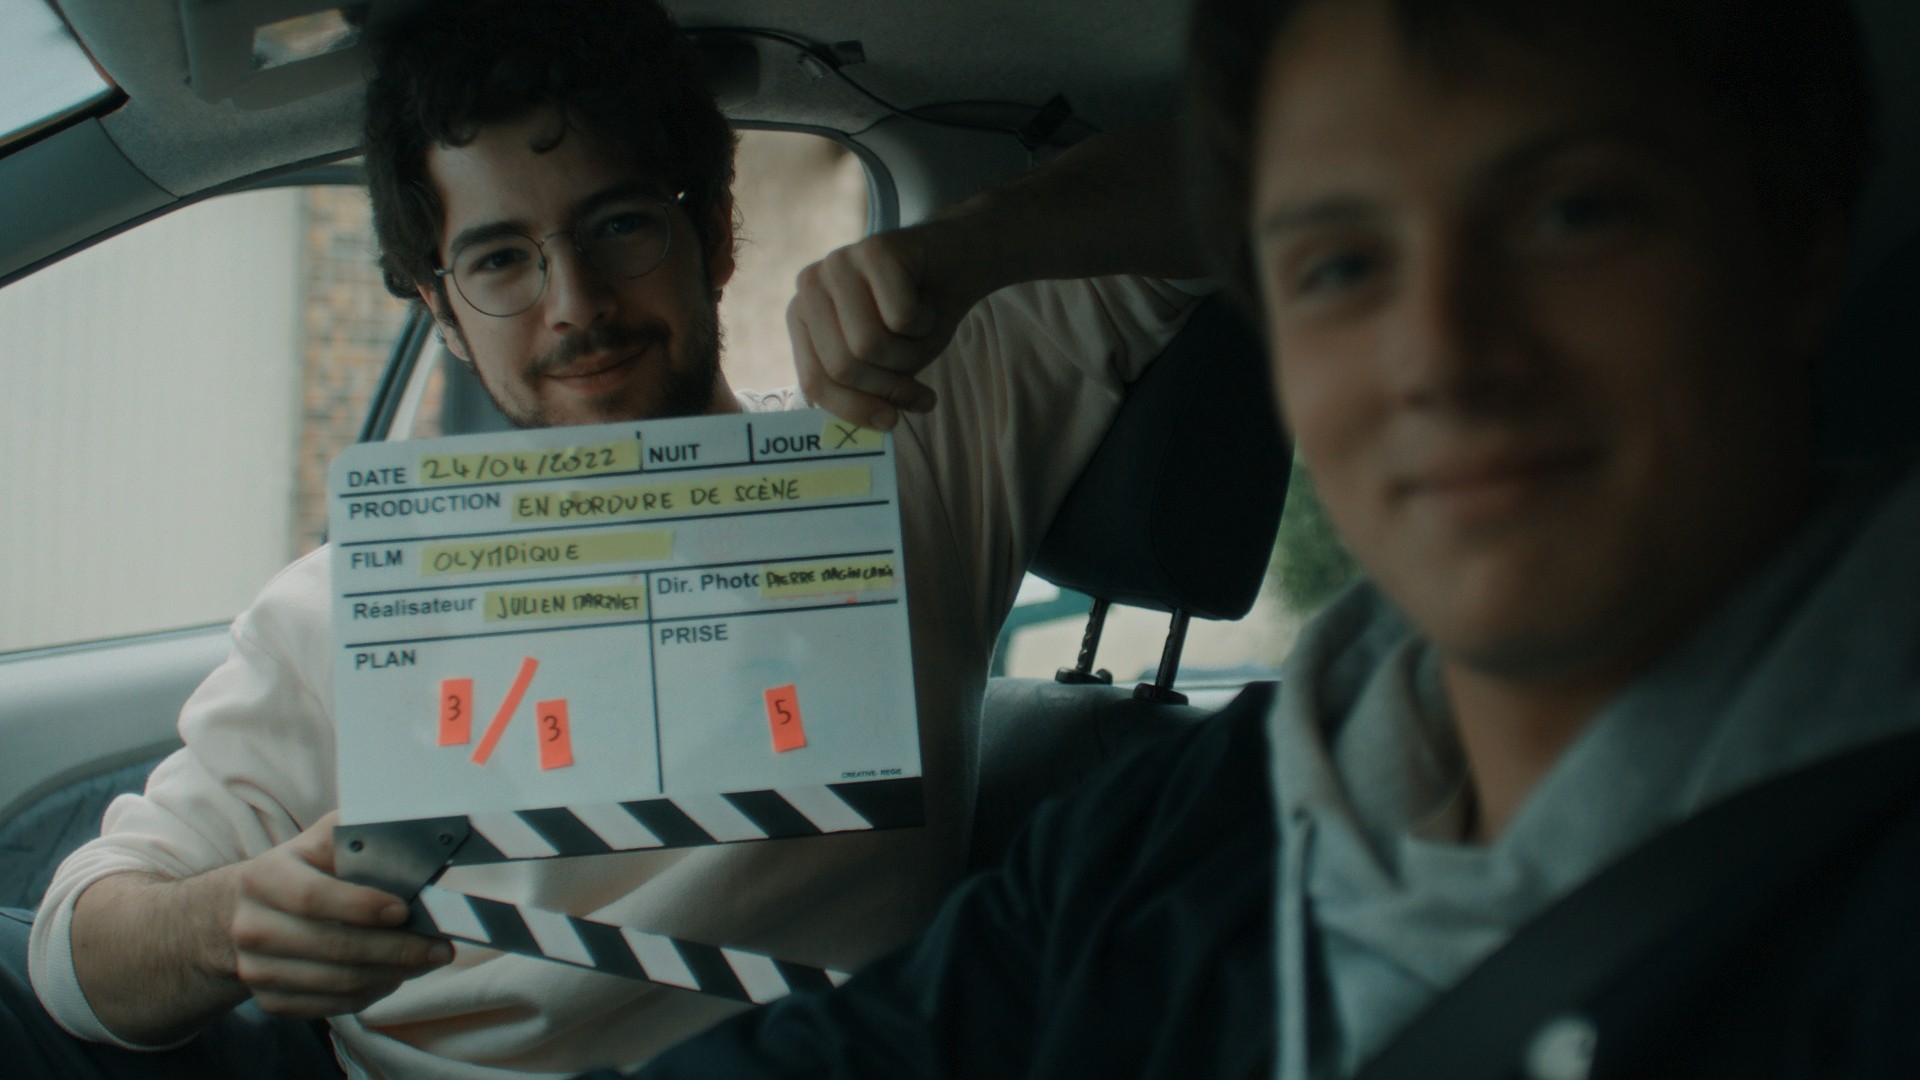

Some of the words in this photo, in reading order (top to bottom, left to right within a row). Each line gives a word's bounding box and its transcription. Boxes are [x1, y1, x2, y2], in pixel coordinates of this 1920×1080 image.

[649, 443, 701, 464] NUIT
[760, 434, 822, 455] JOUR
[422, 448, 617, 480] 24/04/2022
[347, 467, 407, 488] DATE
[349, 491, 500, 520] PRODUCTION
[518, 497, 549, 518] EN
[559, 492, 672, 519] BORDURE
[690, 486, 722, 506] DE
[735, 478, 800, 502] SCÈNE
[351, 550, 403, 570] FILM
[657, 576, 693, 595] Dir.
[352, 597, 477, 620] Réalisateur
[496, 594, 566, 619] JULIEN
[660, 623, 729, 646] PRISE
[355, 649, 416, 671] PLAN
[448, 694, 462, 722] 3
[543, 714, 561, 743] 3
[774, 698, 792, 726] 5
